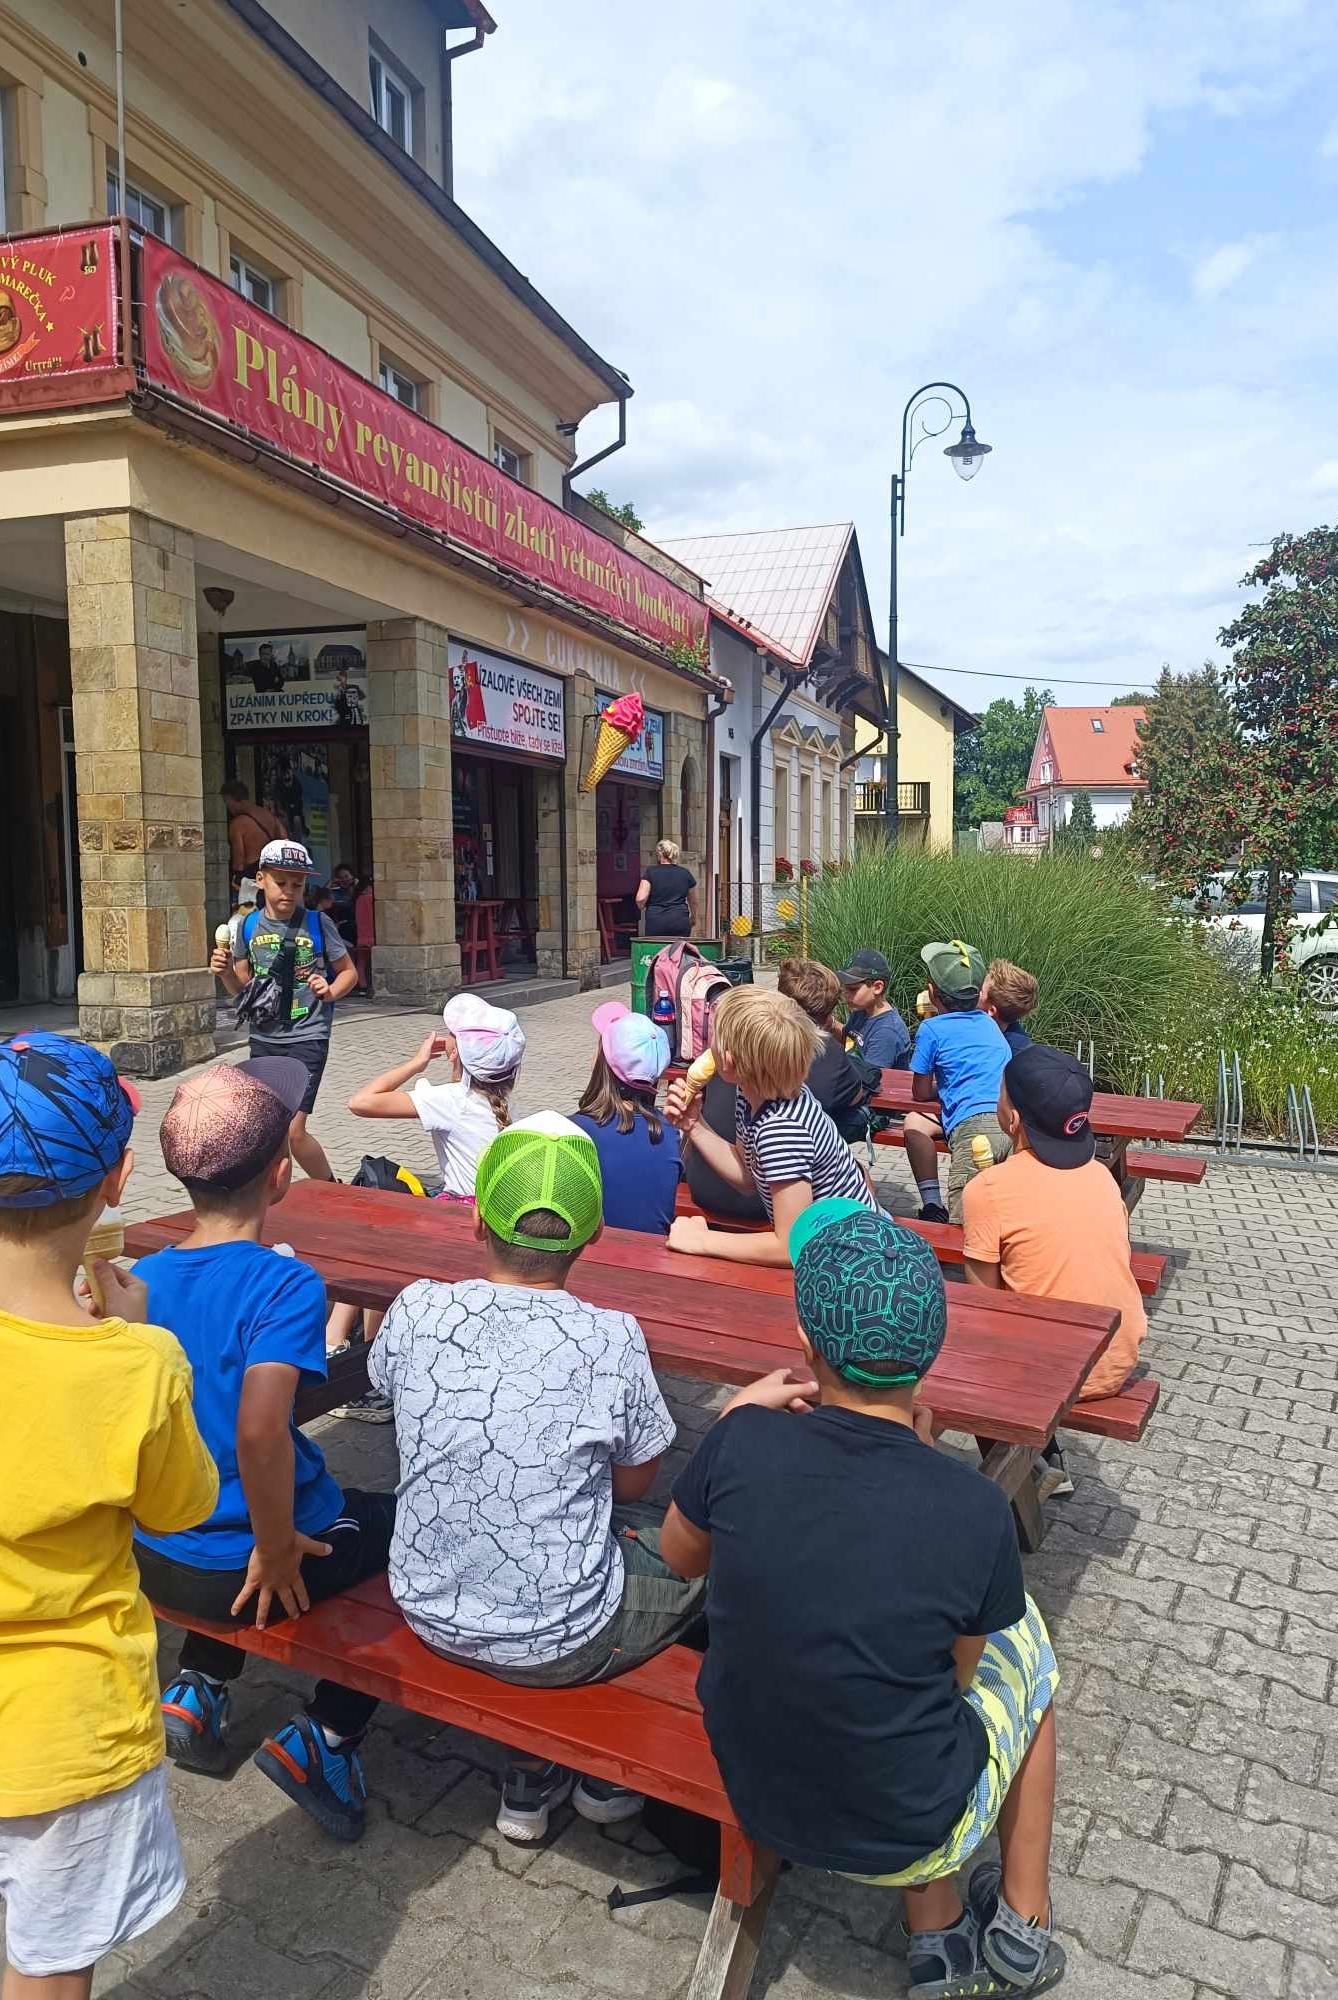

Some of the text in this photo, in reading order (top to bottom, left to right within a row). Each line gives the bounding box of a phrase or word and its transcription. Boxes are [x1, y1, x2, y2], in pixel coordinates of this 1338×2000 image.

[22, 260, 57, 287] PLUK
[0, 272, 47, 322] MAREČKA
[232, 324, 345, 452] Plány
[355, 419, 498, 530] revanšistů
[504, 505, 557, 562] zhatí
[517, 678, 543, 704] VŠECH
[230, 708, 333, 726] ZPÁTKY NI KROK!
[513, 702, 561, 733] SPOJTE SE!
